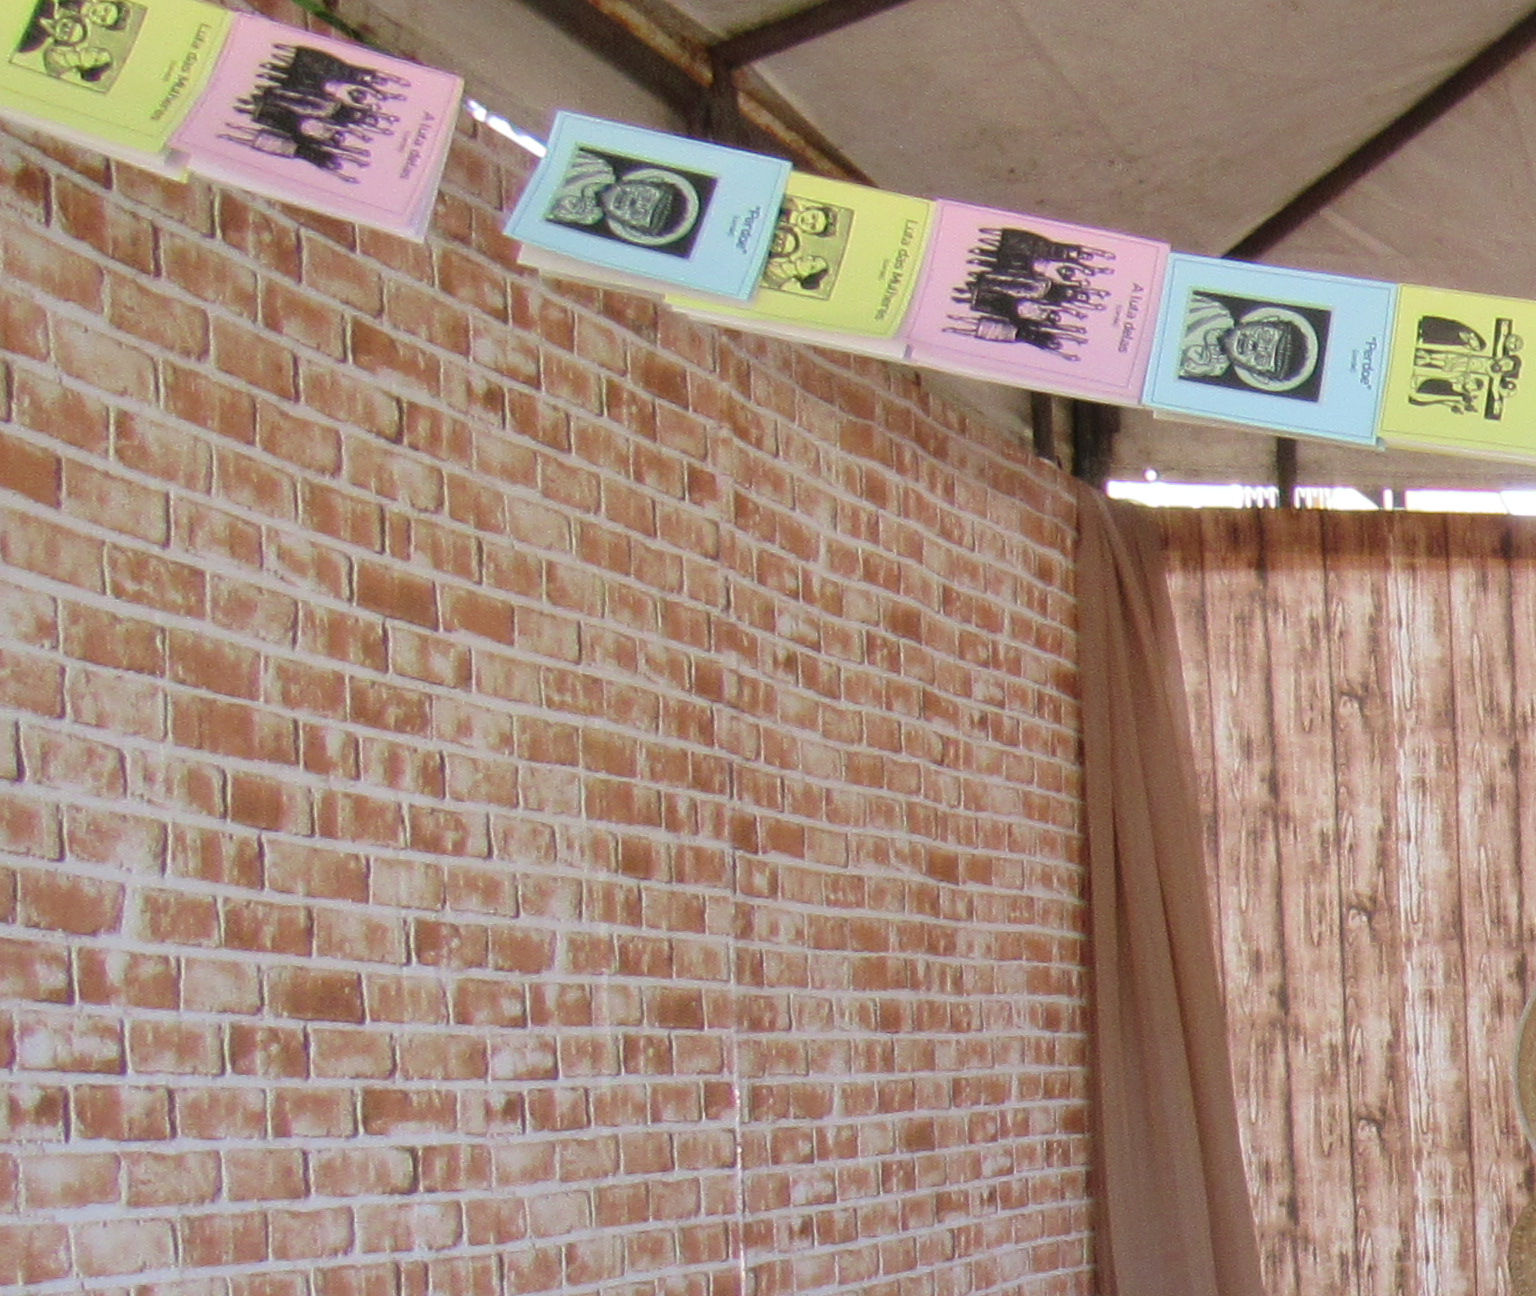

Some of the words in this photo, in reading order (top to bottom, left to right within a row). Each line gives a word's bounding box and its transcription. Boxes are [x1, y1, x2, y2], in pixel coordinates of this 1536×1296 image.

[425, 112, 435, 120] A
[901, 219, 918, 245] Luta
[893, 248, 910, 270] das
[875, 271, 903, 321] Mulheres
[1132, 282, 1144, 292] A
[1128, 296, 1142, 319] luta
[1119, 322, 1135, 353] delas
